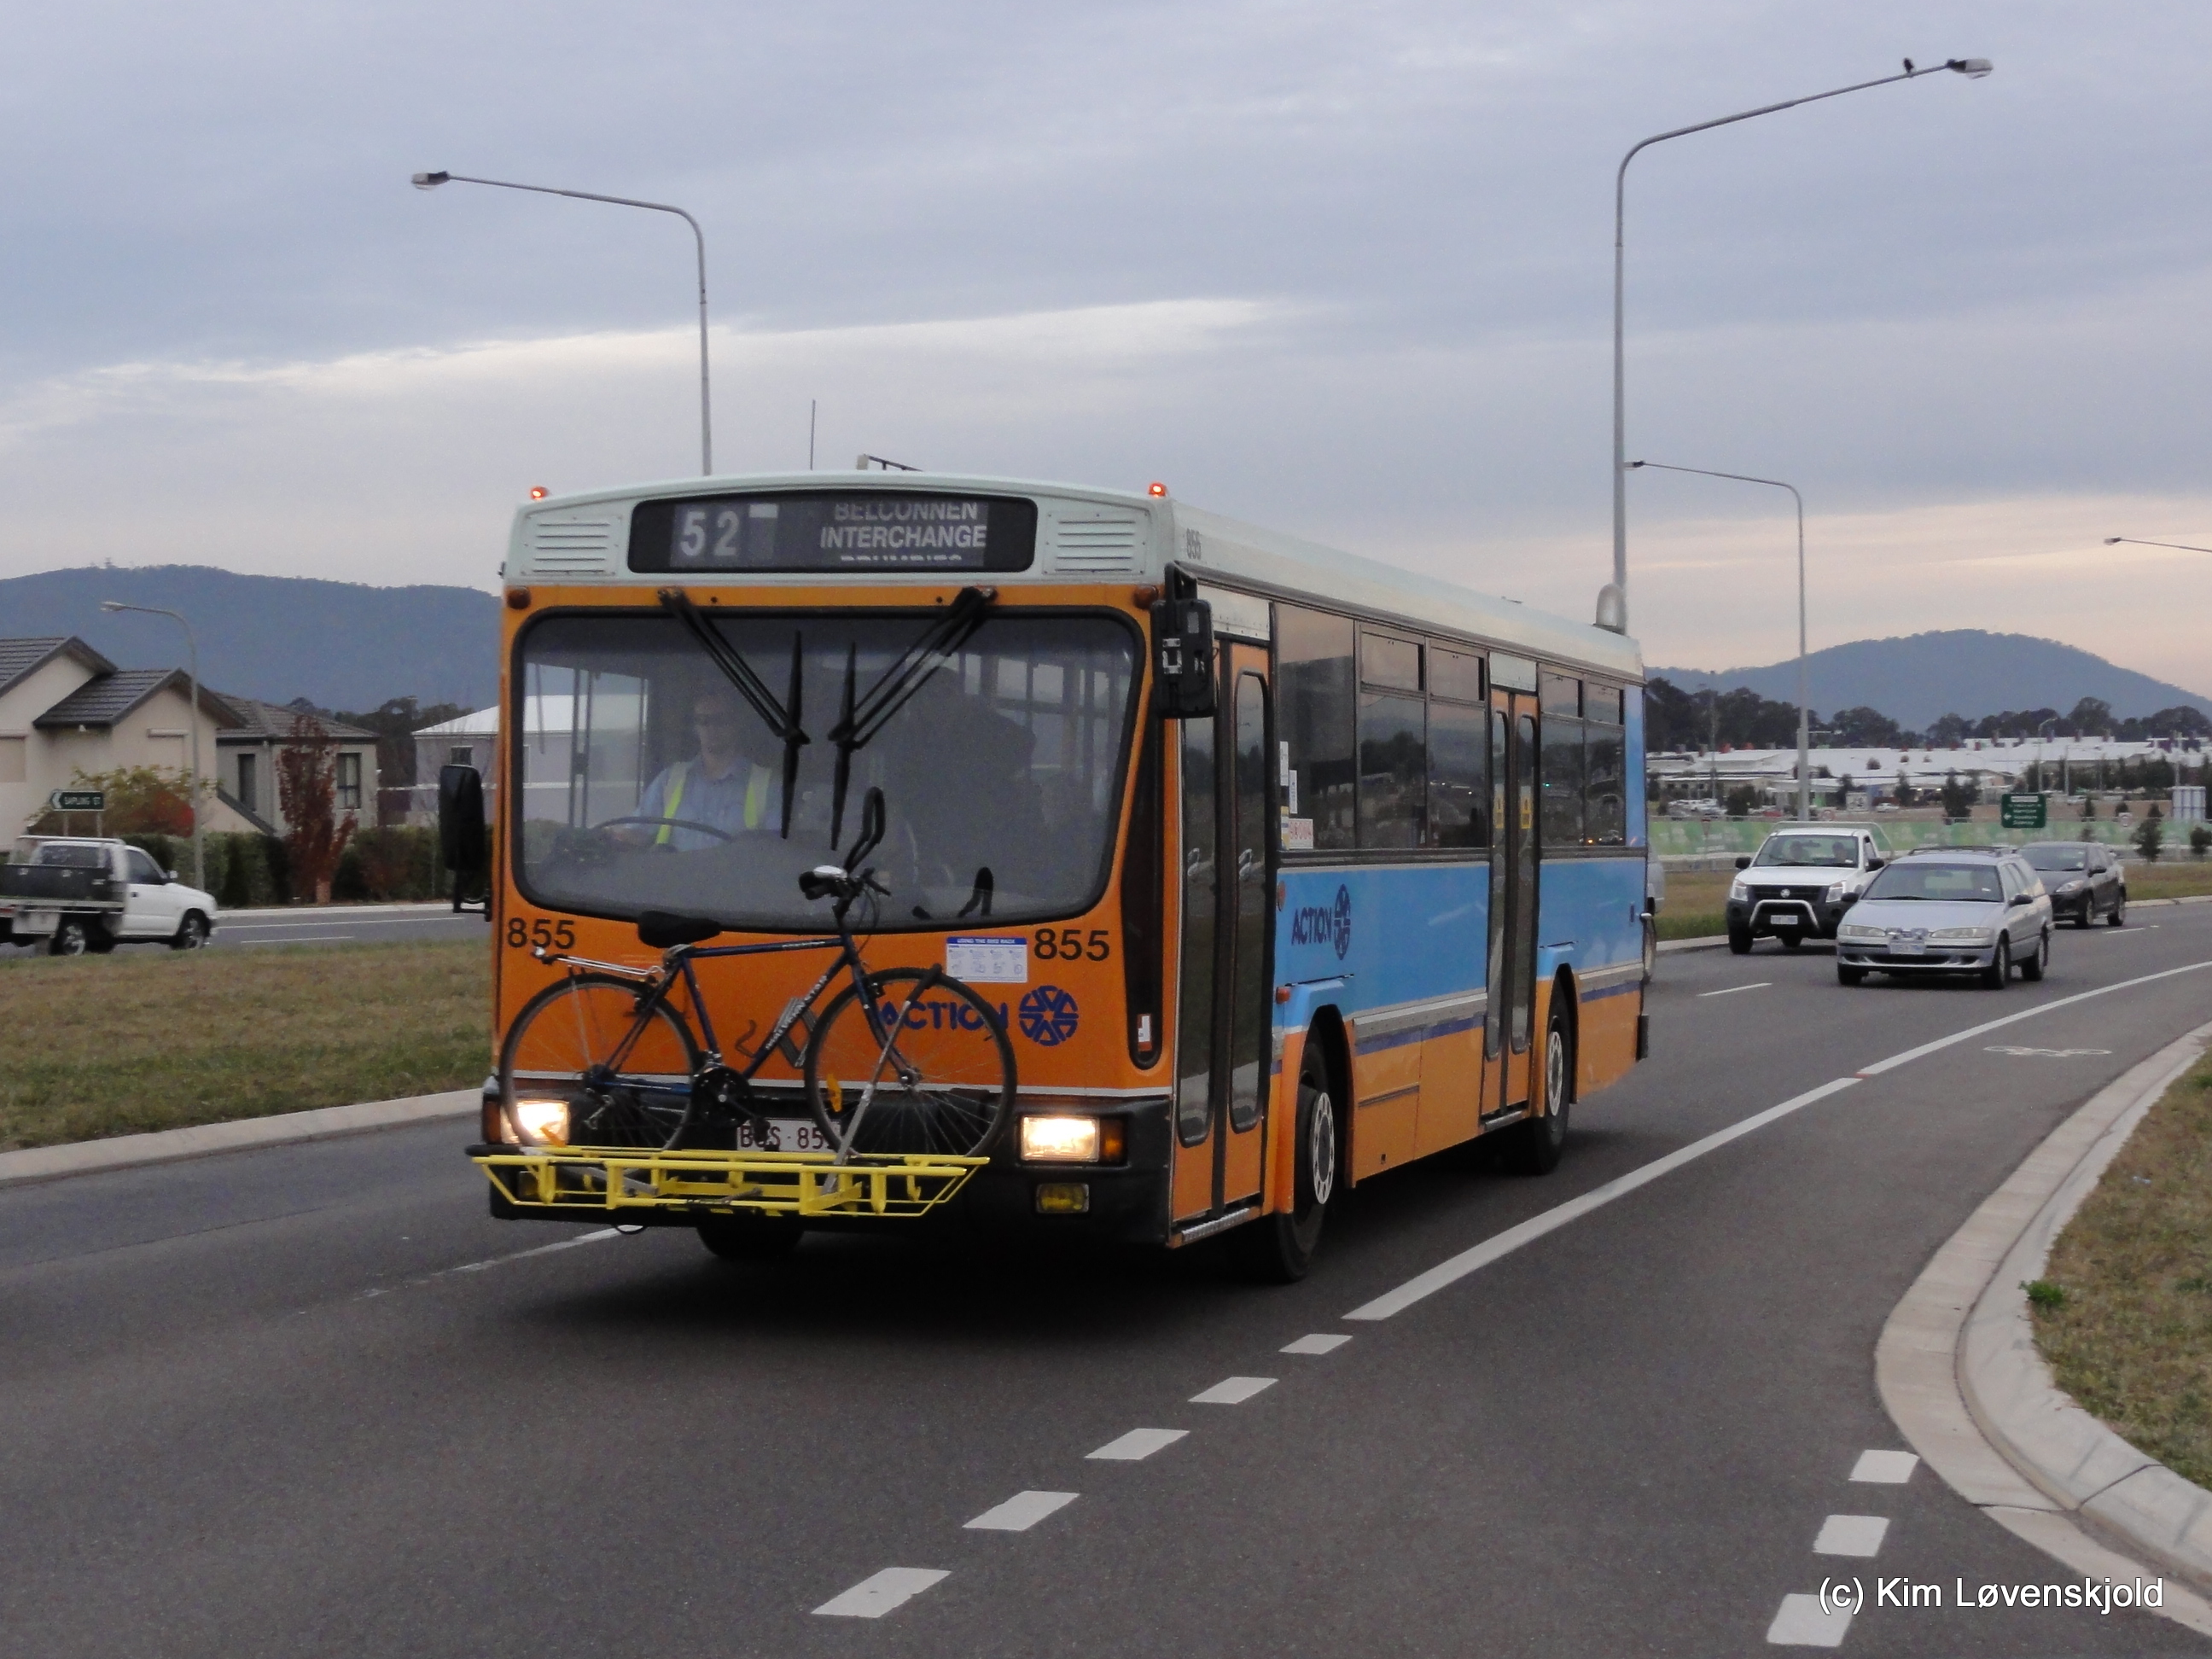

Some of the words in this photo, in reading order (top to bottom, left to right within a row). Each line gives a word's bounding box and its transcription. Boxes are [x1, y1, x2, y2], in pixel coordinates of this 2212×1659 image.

[820, 525, 987, 548] INTERCHANGE
[508, 917, 575, 949] 855
[1291, 907, 1332, 946] ACTION
[1034, 928, 1109, 961] 855
[798, 1127, 837, 1150] 85
